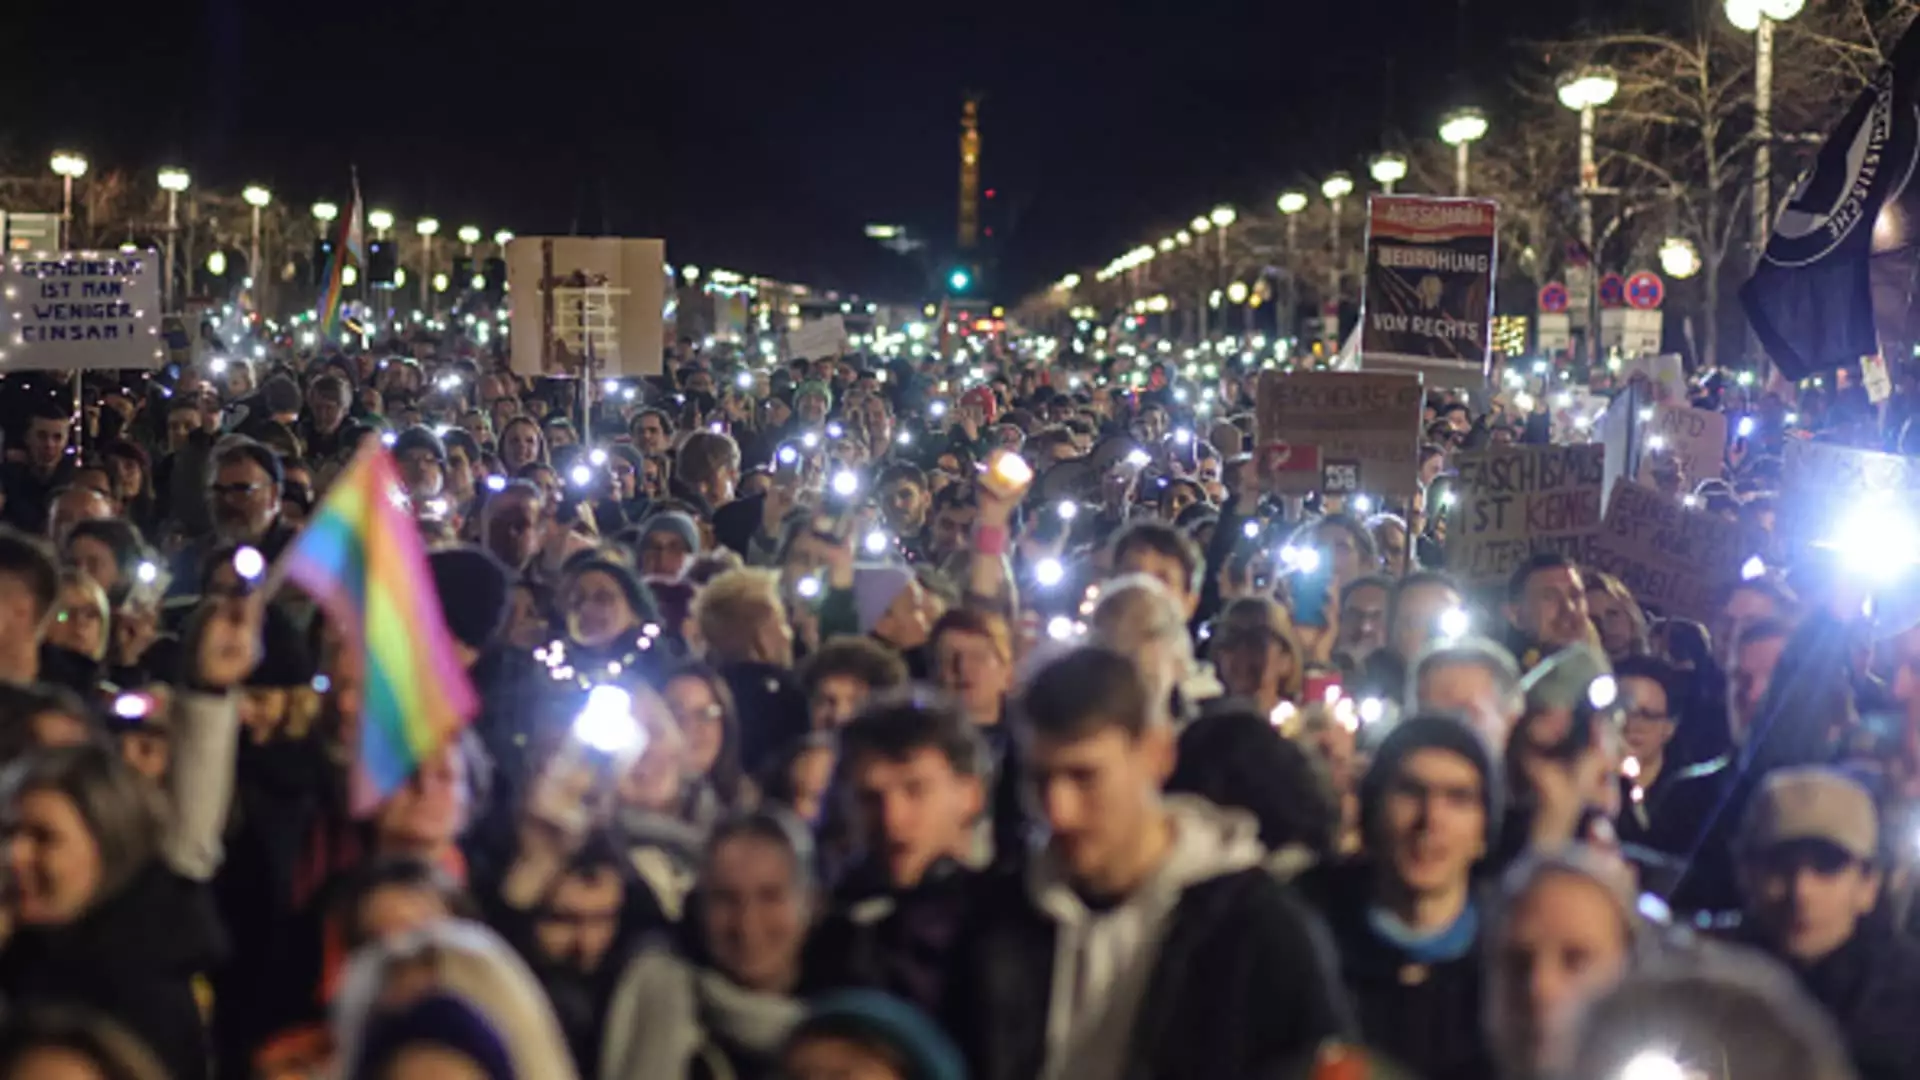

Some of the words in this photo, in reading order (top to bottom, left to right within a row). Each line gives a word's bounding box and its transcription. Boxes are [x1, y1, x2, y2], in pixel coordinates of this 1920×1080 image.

[1377, 247, 1489, 272] BEDROHUNG
[41, 282, 71, 298] IST
[82, 282, 122, 297] MAN
[33, 303, 135, 320] WENIGER
[22, 325, 118, 342] EINSAM
[1372, 313, 1408, 332] VON
[1411, 316, 1480, 340] RECHTS
[1459, 447, 1604, 494] FASCHISMUS
[1459, 495, 1513, 537] IST
